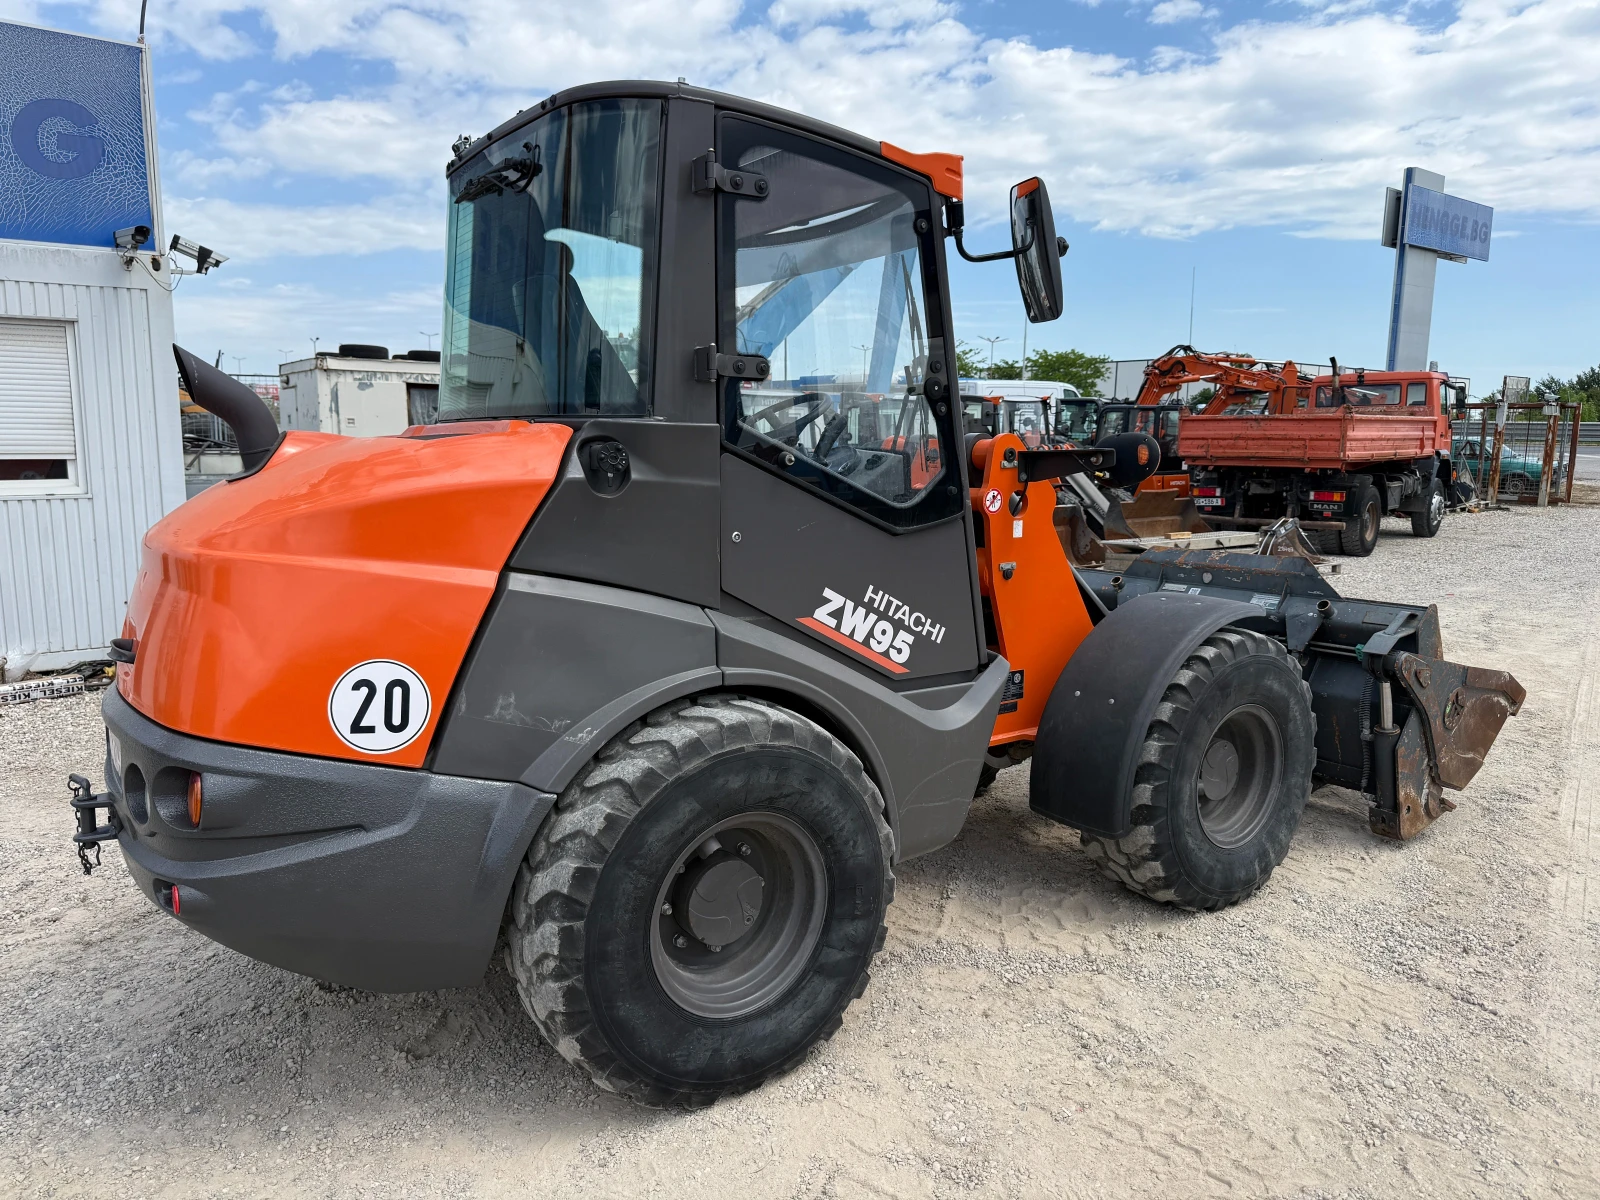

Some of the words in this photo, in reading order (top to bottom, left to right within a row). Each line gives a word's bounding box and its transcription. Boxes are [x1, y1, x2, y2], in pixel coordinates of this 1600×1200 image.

[812, 587, 915, 664] ZW95
[863, 584, 946, 644] HITACHI
[40, 685, 84, 697] KIESEL
[350, 678, 411, 734] 20
